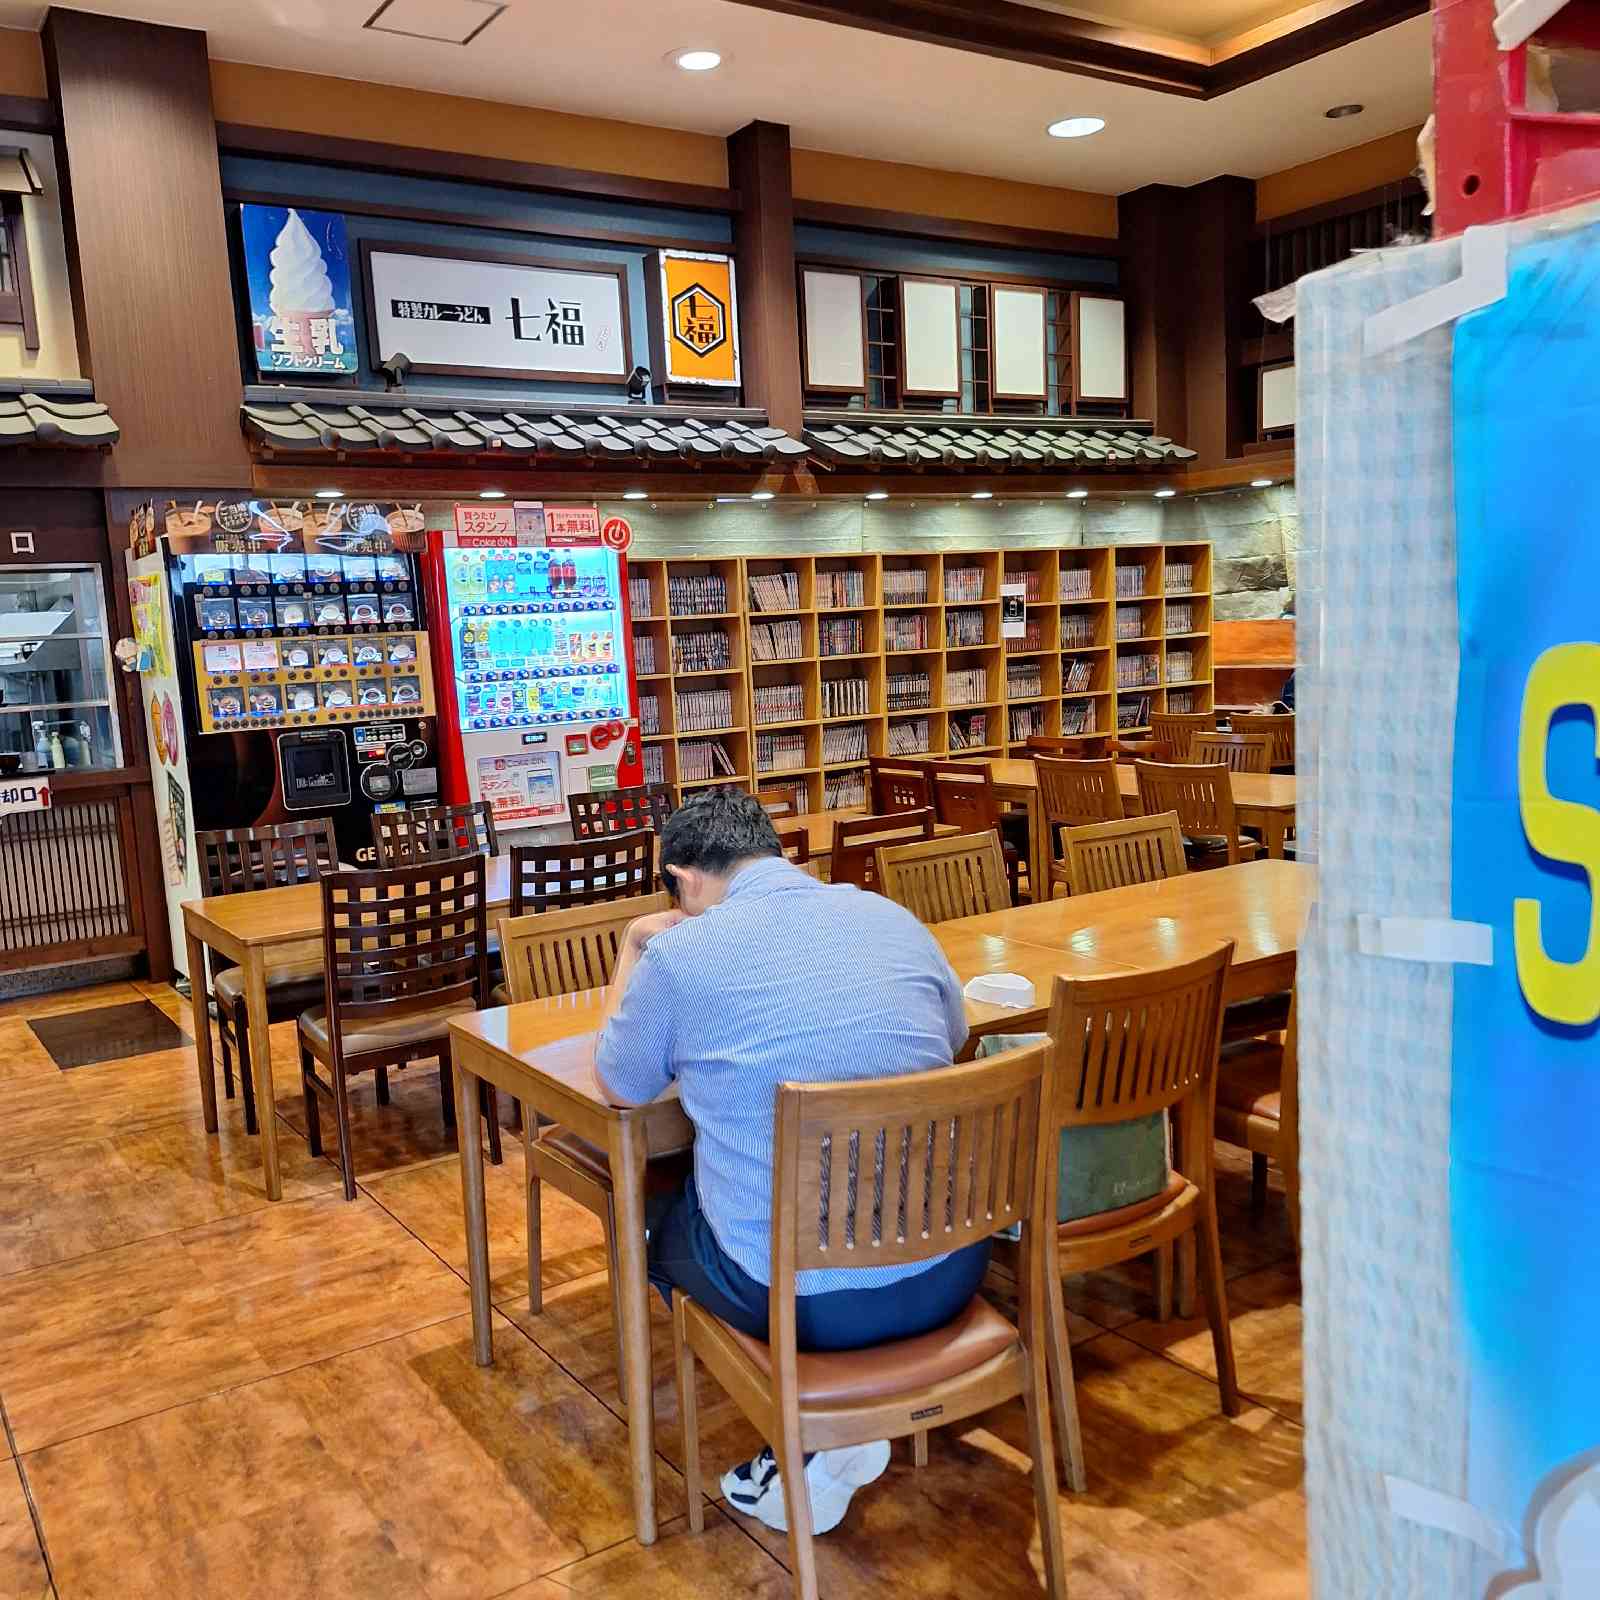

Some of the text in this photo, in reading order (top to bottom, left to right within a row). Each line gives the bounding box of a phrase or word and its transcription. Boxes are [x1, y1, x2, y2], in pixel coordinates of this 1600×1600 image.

[398, 302, 484, 323] 特製カレーうどん
[505, 298, 584, 345] 七福
[271, 353, 345, 369] ソフトクリーム
[464, 511, 496, 521] 買うたび
[464, 520, 509, 533] スタンプ
